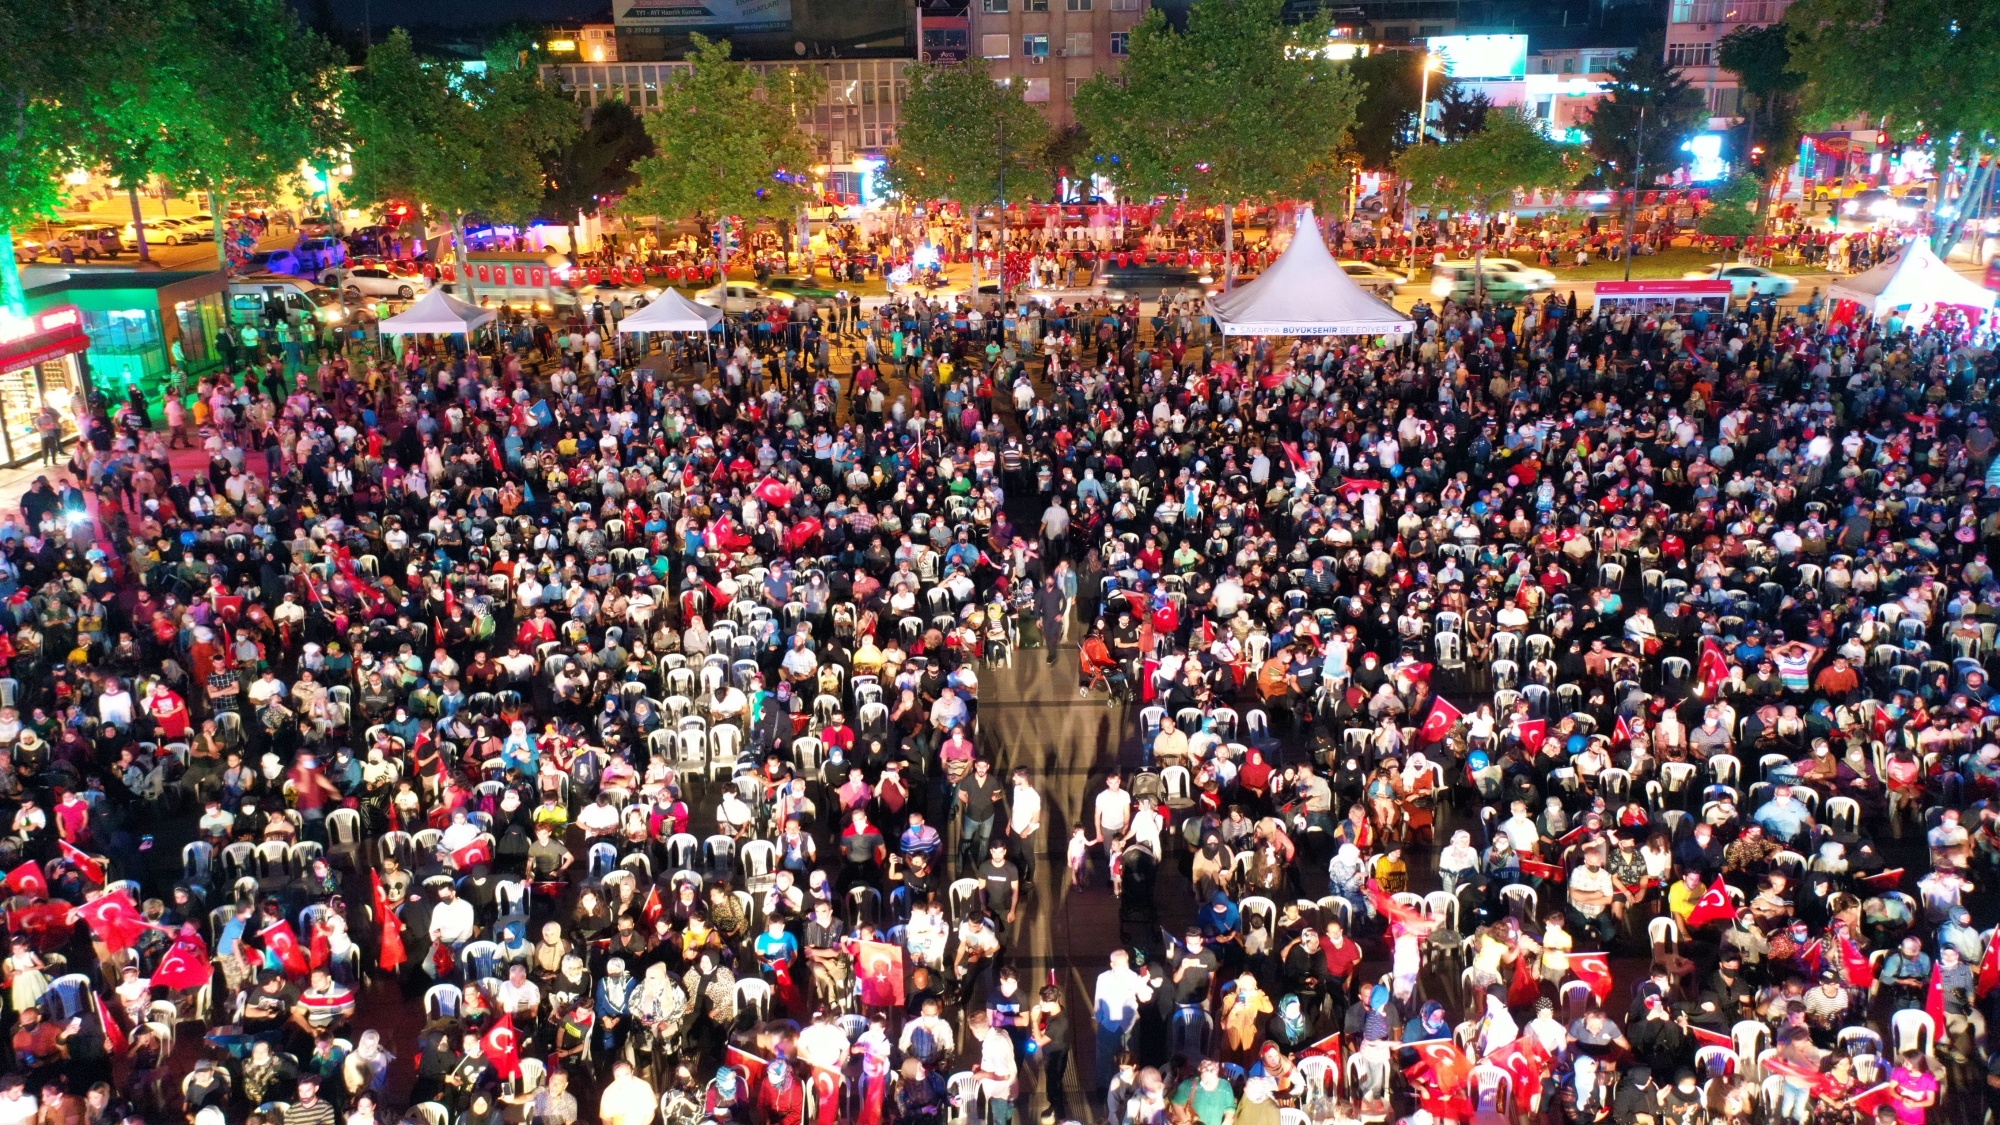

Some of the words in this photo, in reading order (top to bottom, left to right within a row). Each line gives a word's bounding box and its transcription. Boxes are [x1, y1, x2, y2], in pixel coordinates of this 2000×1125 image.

[1240, 326, 1280, 334] SAKARYA
[1282, 326, 1338, 334] BÜYÜKŞEHİR
[1340, 325, 1389, 333] BELEDİYESİ
